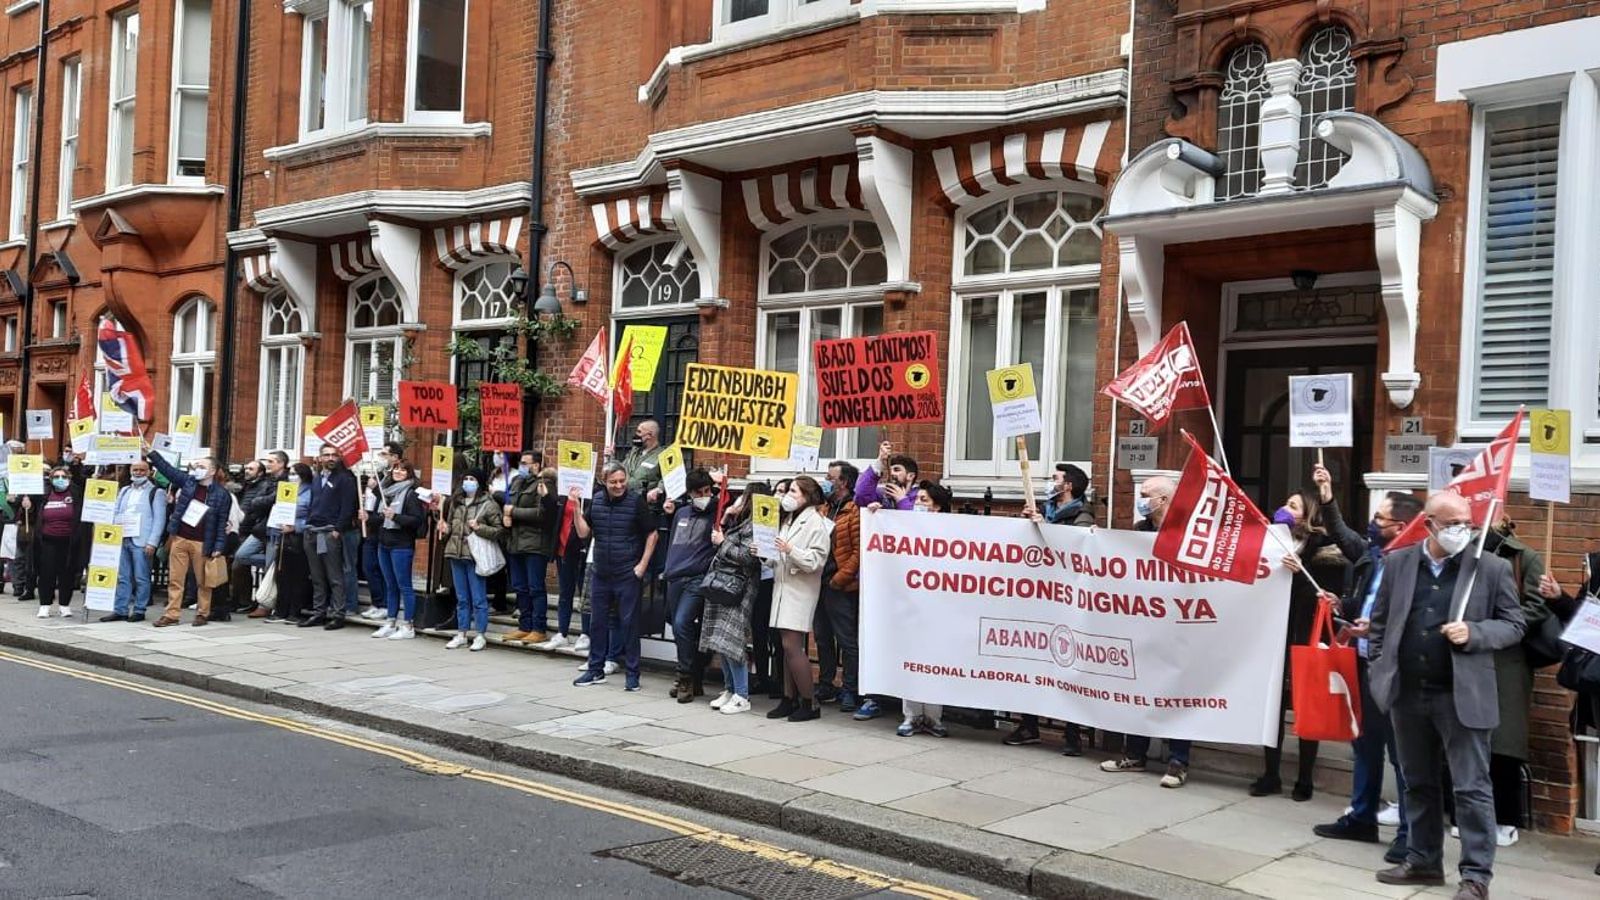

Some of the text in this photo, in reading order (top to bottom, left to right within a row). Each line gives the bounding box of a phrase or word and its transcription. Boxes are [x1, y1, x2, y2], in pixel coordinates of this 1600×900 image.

[658, 284, 672, 301] 19
[490, 301, 501, 317] 17
[864, 334, 932, 364] MINIMOS!
[412, 385, 444, 401] TODO
[686, 366, 787, 401] EDINBURGH
[821, 365, 894, 397] SUELDOS
[409, 404, 448, 424] MAL
[683, 392, 788, 429] MANCHESTER
[822, 394, 916, 425] CONGELADOS
[484, 431, 520, 448] EXISTE
[679, 419, 745, 451] LONDON
[1131, 422, 1144, 434] 21
[1405, 420, 1420, 433] 21
[867, 533, 1271, 583] ABANDONAD@S Y BAJO MINS
[905, 569, 1217, 620] CONDICIONES DIGNAS YA
[903, 661, 1228, 709] PERSONAL LABORAL SIN CONVENIO EN EL EXTERIOR
